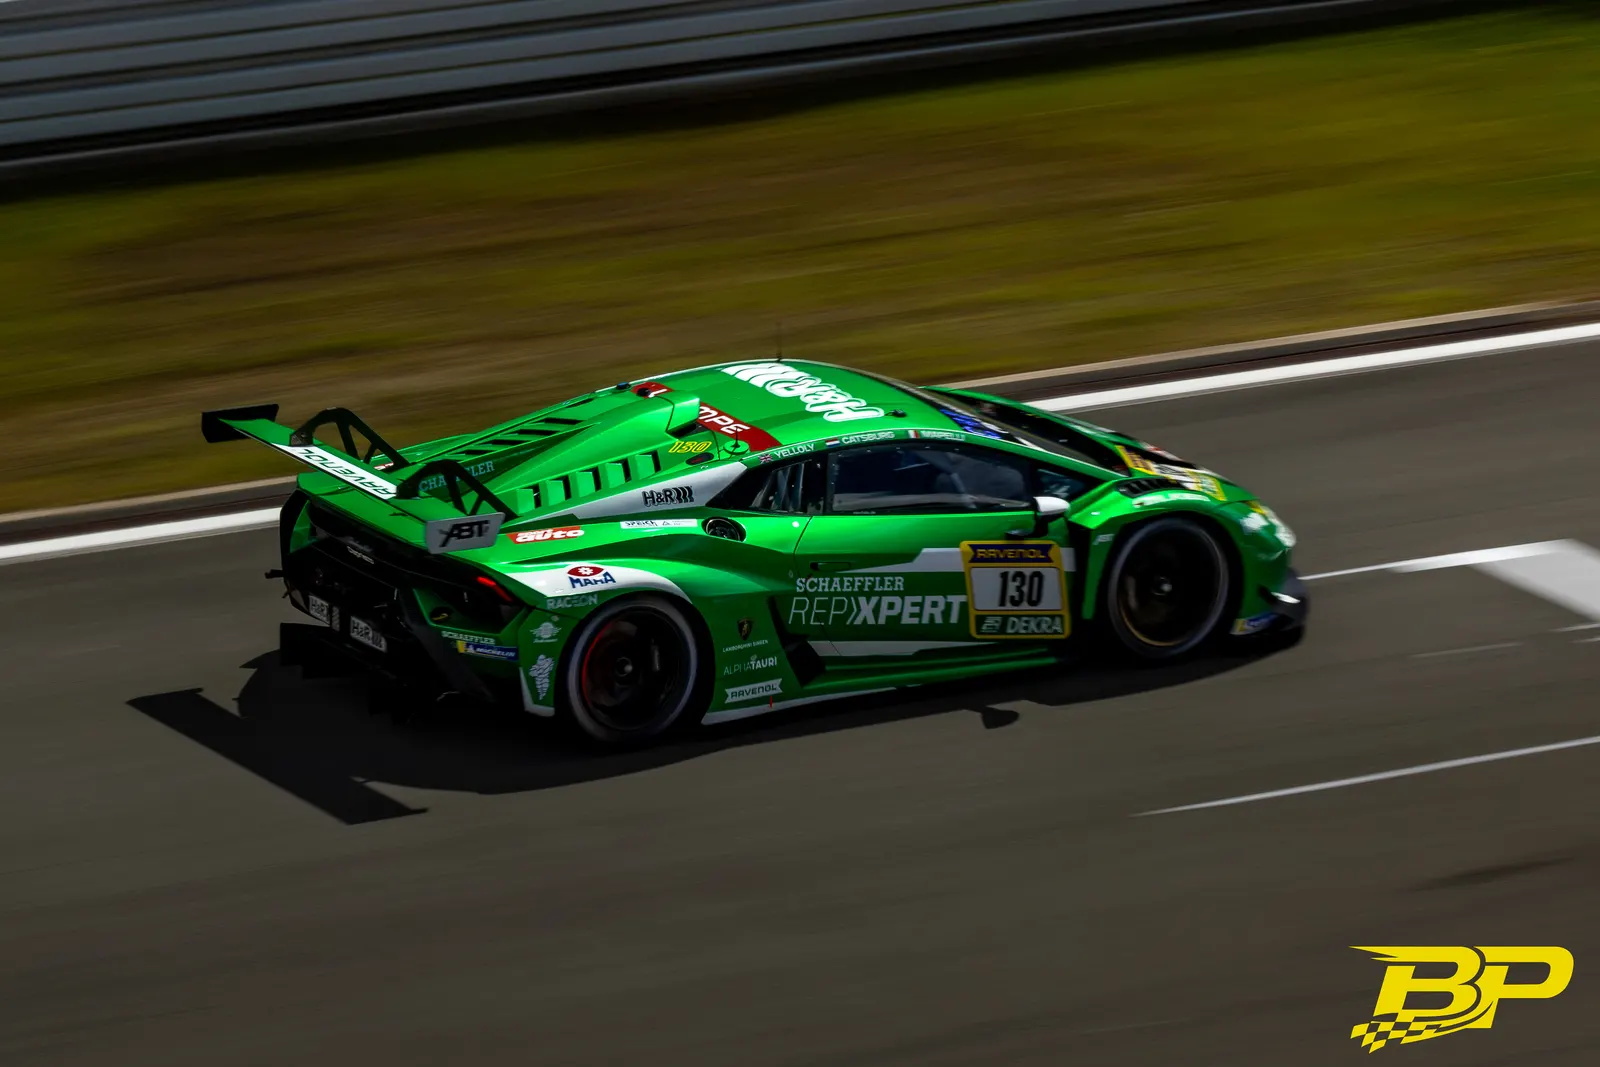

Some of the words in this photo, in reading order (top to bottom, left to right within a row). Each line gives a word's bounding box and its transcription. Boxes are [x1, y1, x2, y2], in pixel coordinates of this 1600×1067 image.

[841, 431, 895, 445] CATSBURG
[668, 441, 712, 453] 130
[774, 443, 815, 459] YELLOLY
[299, 448, 397, 495] RAVENOL
[418, 460, 495, 492] CHALER
[438, 519, 491, 547] ABT
[976, 549, 1046, 559] RAVENOL
[568, 571, 617, 589] MAHA
[796, 576, 905, 593] SCHAEFFLER
[998, 570, 1043, 607] 130
[1006, 616, 1063, 634] DEKRA
[730, 684, 777, 699] RAVENOL
